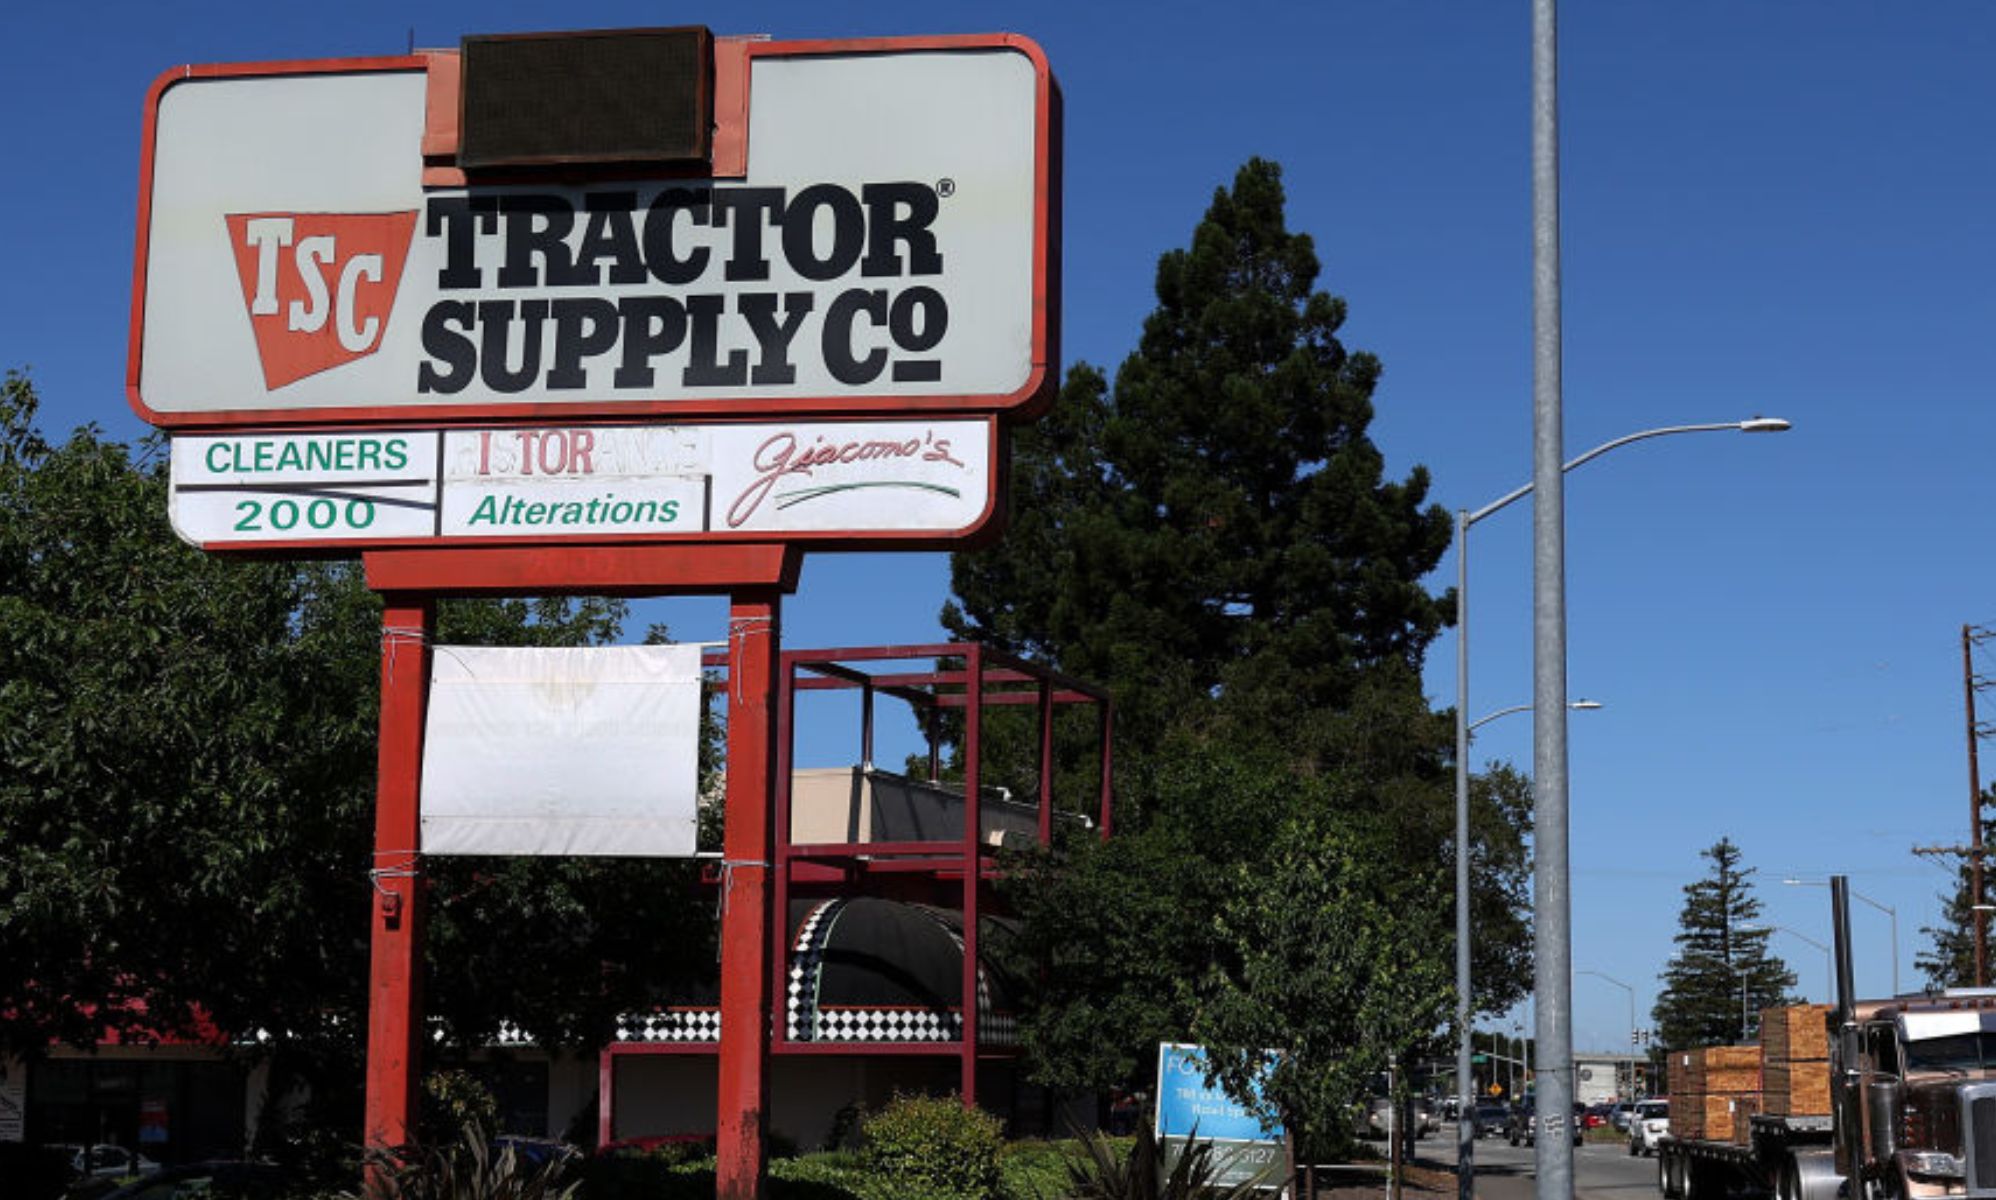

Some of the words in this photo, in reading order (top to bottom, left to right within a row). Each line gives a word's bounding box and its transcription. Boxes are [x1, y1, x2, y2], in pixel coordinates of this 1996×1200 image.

[245, 216, 383, 353] TSC
[417, 291, 815, 394] SUPPLY
[205, 438, 408, 474] CLEANERS
[726, 430, 965, 528] Giacomo's
[233, 499, 376, 531] 2000
[468, 493, 680, 526] Alterations
